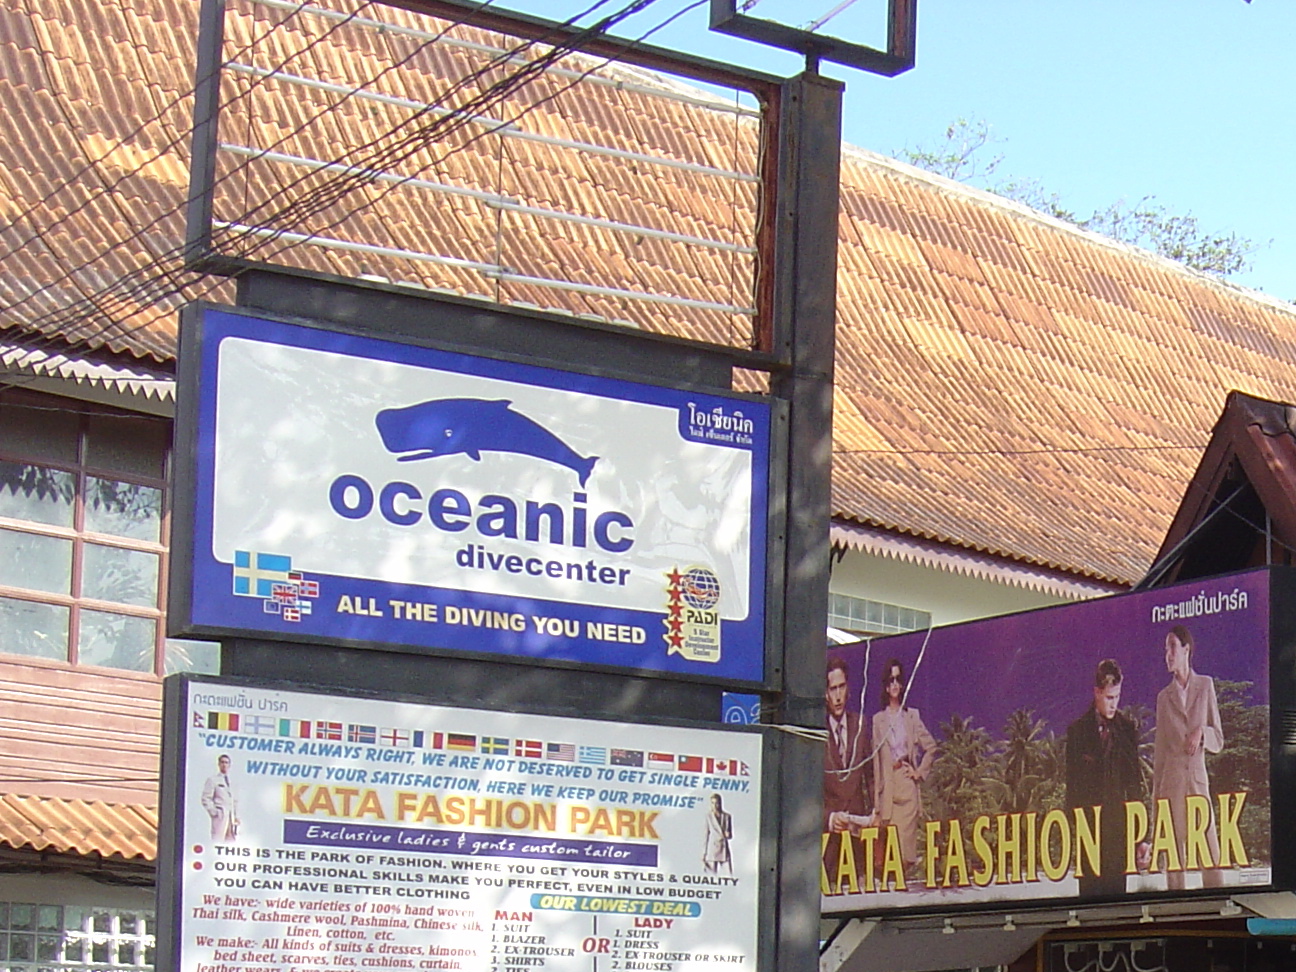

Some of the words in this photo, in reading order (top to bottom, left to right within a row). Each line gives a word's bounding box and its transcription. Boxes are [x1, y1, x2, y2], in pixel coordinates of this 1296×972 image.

[329, 474, 635, 553] oceanic
[456, 544, 631, 586] divecenter
[337, 594, 383, 618] ALL
[389, 600, 438, 623] THE
[444, 606, 526, 631] DIVING
[532, 616, 579, 637] YOU
[586, 622, 646, 645] NEED
[687, 610, 718, 625] PADI
[298, 742, 360, 759] ALWAYS
[365, 748, 414, 765] RIGHT,
[421, 752, 446, 766] WE
[448, 755, 478, 769] ARE
[483, 758, 515, 772] NOT
[518, 761, 591, 778] DESERVED
[597, 767, 615, 780] TO
[617, 769, 646, 783] GET
[649, 771, 698, 787] SINGLE
[702, 776, 750, 792] PENNY,
[246, 760, 322, 779] WITHOUT
[324, 766, 366, 782] YOUR
[371, 770, 480, 792] SATISFACTION,
[486, 779, 525, 795] HERE
[530, 783, 554, 797] WE
[557, 785, 594, 800] KEEP
[598, 788, 629, 803] OUR
[282, 783, 386, 820] KATA
[396, 791, 556, 832] FASHION
[569, 804, 661, 839] PARK
[305, 825, 391, 843] Exclusive
[397, 831, 449, 847] ladies
[471, 836, 515, 856] gents
[521, 839, 579, 855] custom
[584, 843, 630, 858] tailor
[925, 804, 1103, 889] FASHION
[1125, 791, 1249, 875] PARK
[214, 845, 250, 858] THIS
[256, 848, 270, 859] IS
[275, 849, 305, 861] THE
[311, 851, 350, 863] PARK
[355, 854, 374, 865] OF
[379, 855, 446, 869] FASHION.
[451, 860, 501, 872] WHERE
[507, 863, 535, 874] YOU
[540, 865, 567, 876] GET
[572, 867, 608, 878] YOUR
[613, 869, 665, 881] STYLES
[669, 873, 677, 882] &
[682, 874, 739, 886] QUALITY
[213, 877, 246, 889] YOU
[251, 879, 283, 891] CAN
[288, 881, 328, 893] HAVE
[334, 883, 391, 896] BETTER
[396, 887, 470, 900] CLOTHING
[214, 861, 247, 873] OUR
[253, 864, 367, 880] PROFESSIONAL
[372, 870, 423, 883] SKILLS
[428, 874, 469, 885] MAKE
[474, 876, 503, 887] YOU
[508, 878, 572, 892] PERFECT,
[577, 882, 612, 893] EVEN
[617, 884, 631, 894] IN
[635, 885, 664, 896] LOW
[668, 887, 721, 899] BUDGET
[192, 907, 219, 919] Thai
[251, 910, 310, 923] Cashmere
[203, 894, 222, 905] We
[266, 897, 295, 909] wide
[298, 899, 350, 911] varieties
[354, 902, 366, 912] of
[370, 903, 401, 914] 100%
[404, 905, 433, 916] hand
[539, 894, 575, 909] OUR
[579, 896, 647, 913] LOWEST
[651, 900, 692, 915] DEAL
[494, 910, 533, 922] MAN
[633, 917, 673, 929] LADY
[196, 935, 214, 946] We
[261, 938, 279, 949] All
[282, 939, 315, 950] kinds
[319, 941, 333, 951] of
[334, 941, 362, 952] suits
[365, 943, 374, 953] &
[503, 934, 546, 944] BLAZER
[626, 929, 652, 938] SUIT
[582, 937, 610, 953] OR
[624, 940, 659, 949] DRESS
[213, 950, 237, 961] bed
[503, 956, 545, 966] SHIRTS
[623, 961, 672, 971] BLOUSES
